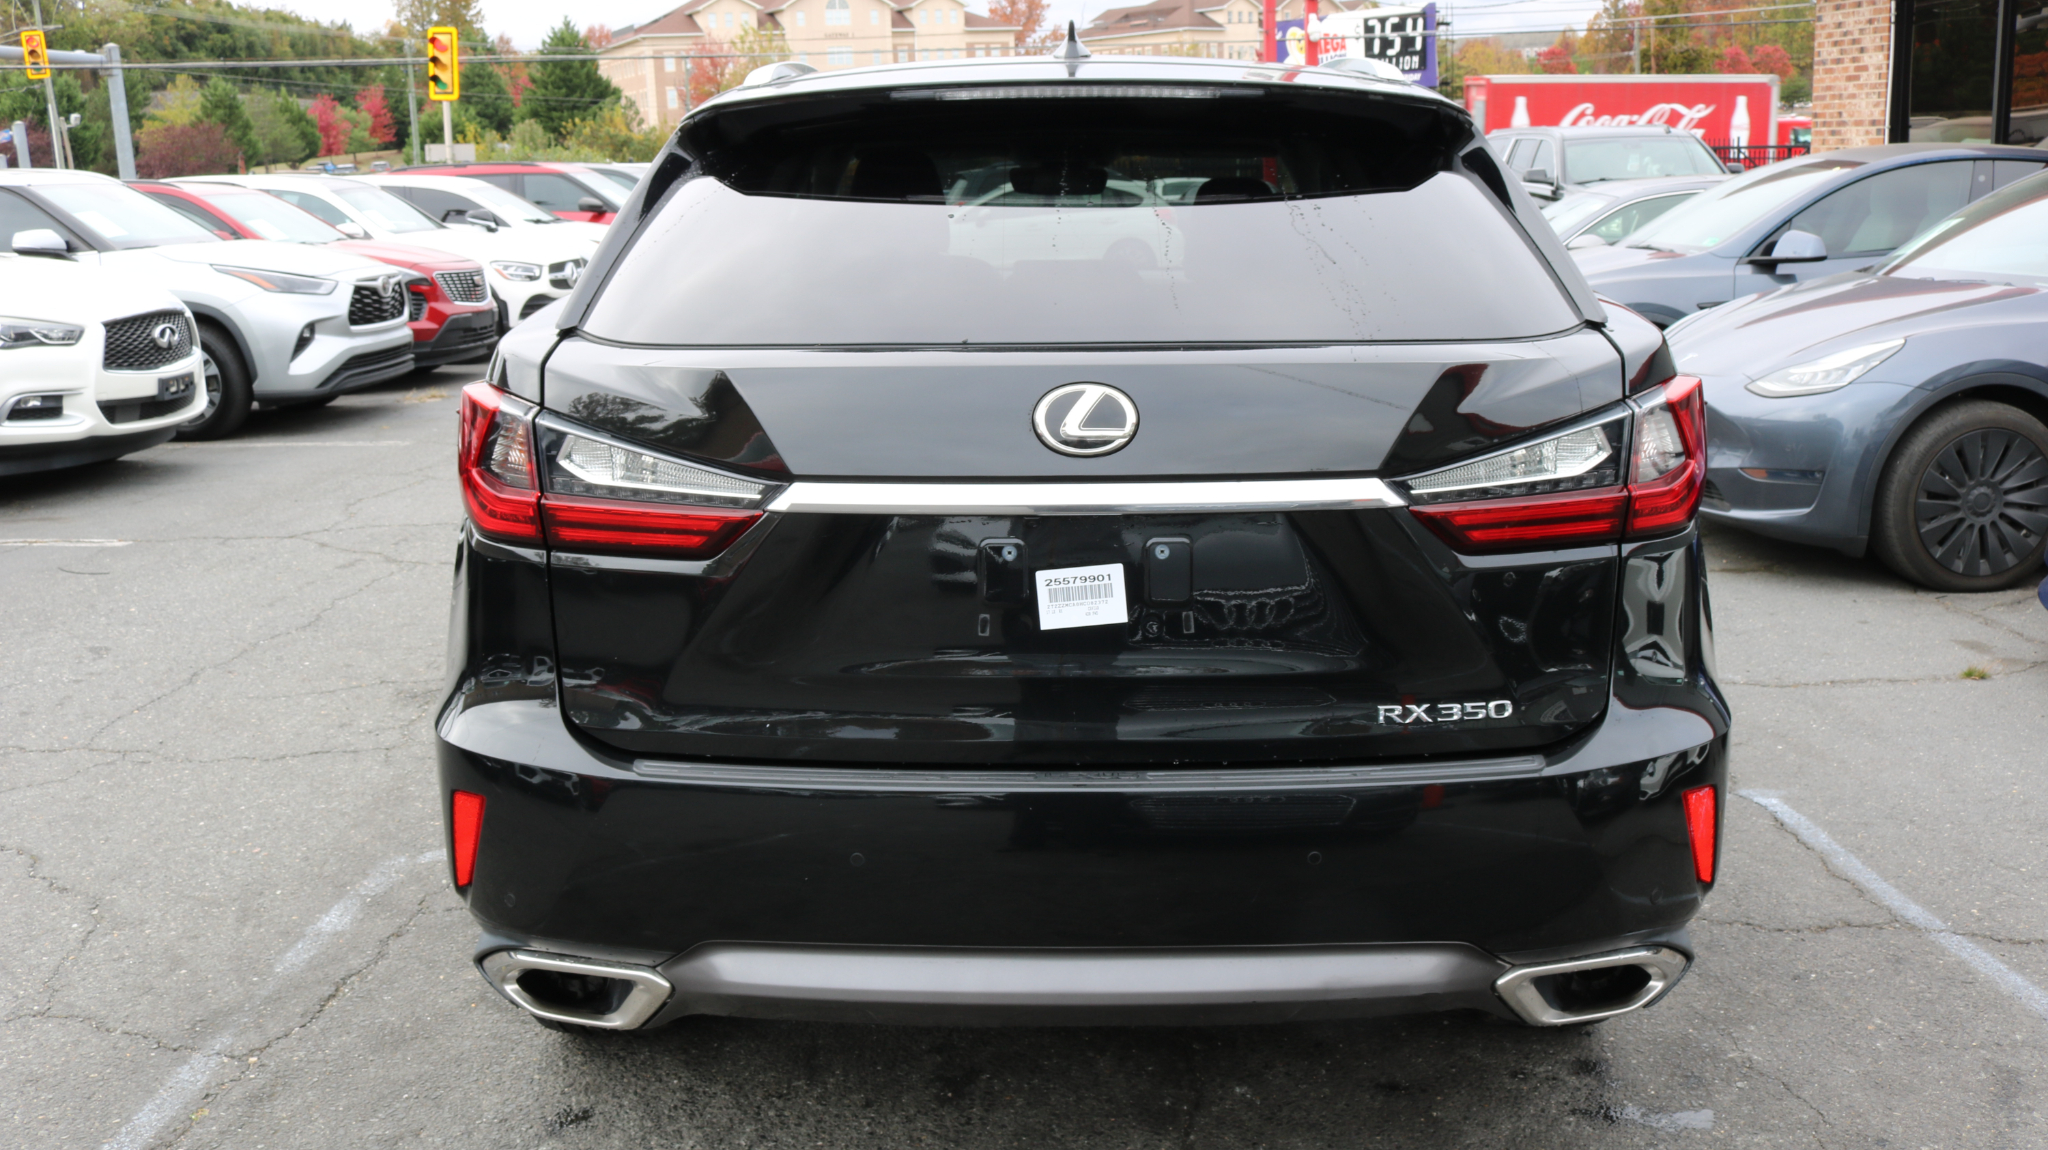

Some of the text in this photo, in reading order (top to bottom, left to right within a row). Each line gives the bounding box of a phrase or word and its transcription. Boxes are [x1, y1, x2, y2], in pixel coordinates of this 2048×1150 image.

[1367, 17, 1424, 56] 754
[1374, 54, 1420, 70] LION
[1559, 102, 1717, 139] Coca-Cl
[1044, 573, 1112, 587] 25579901
[1377, 699, 1513, 724] RX 350
